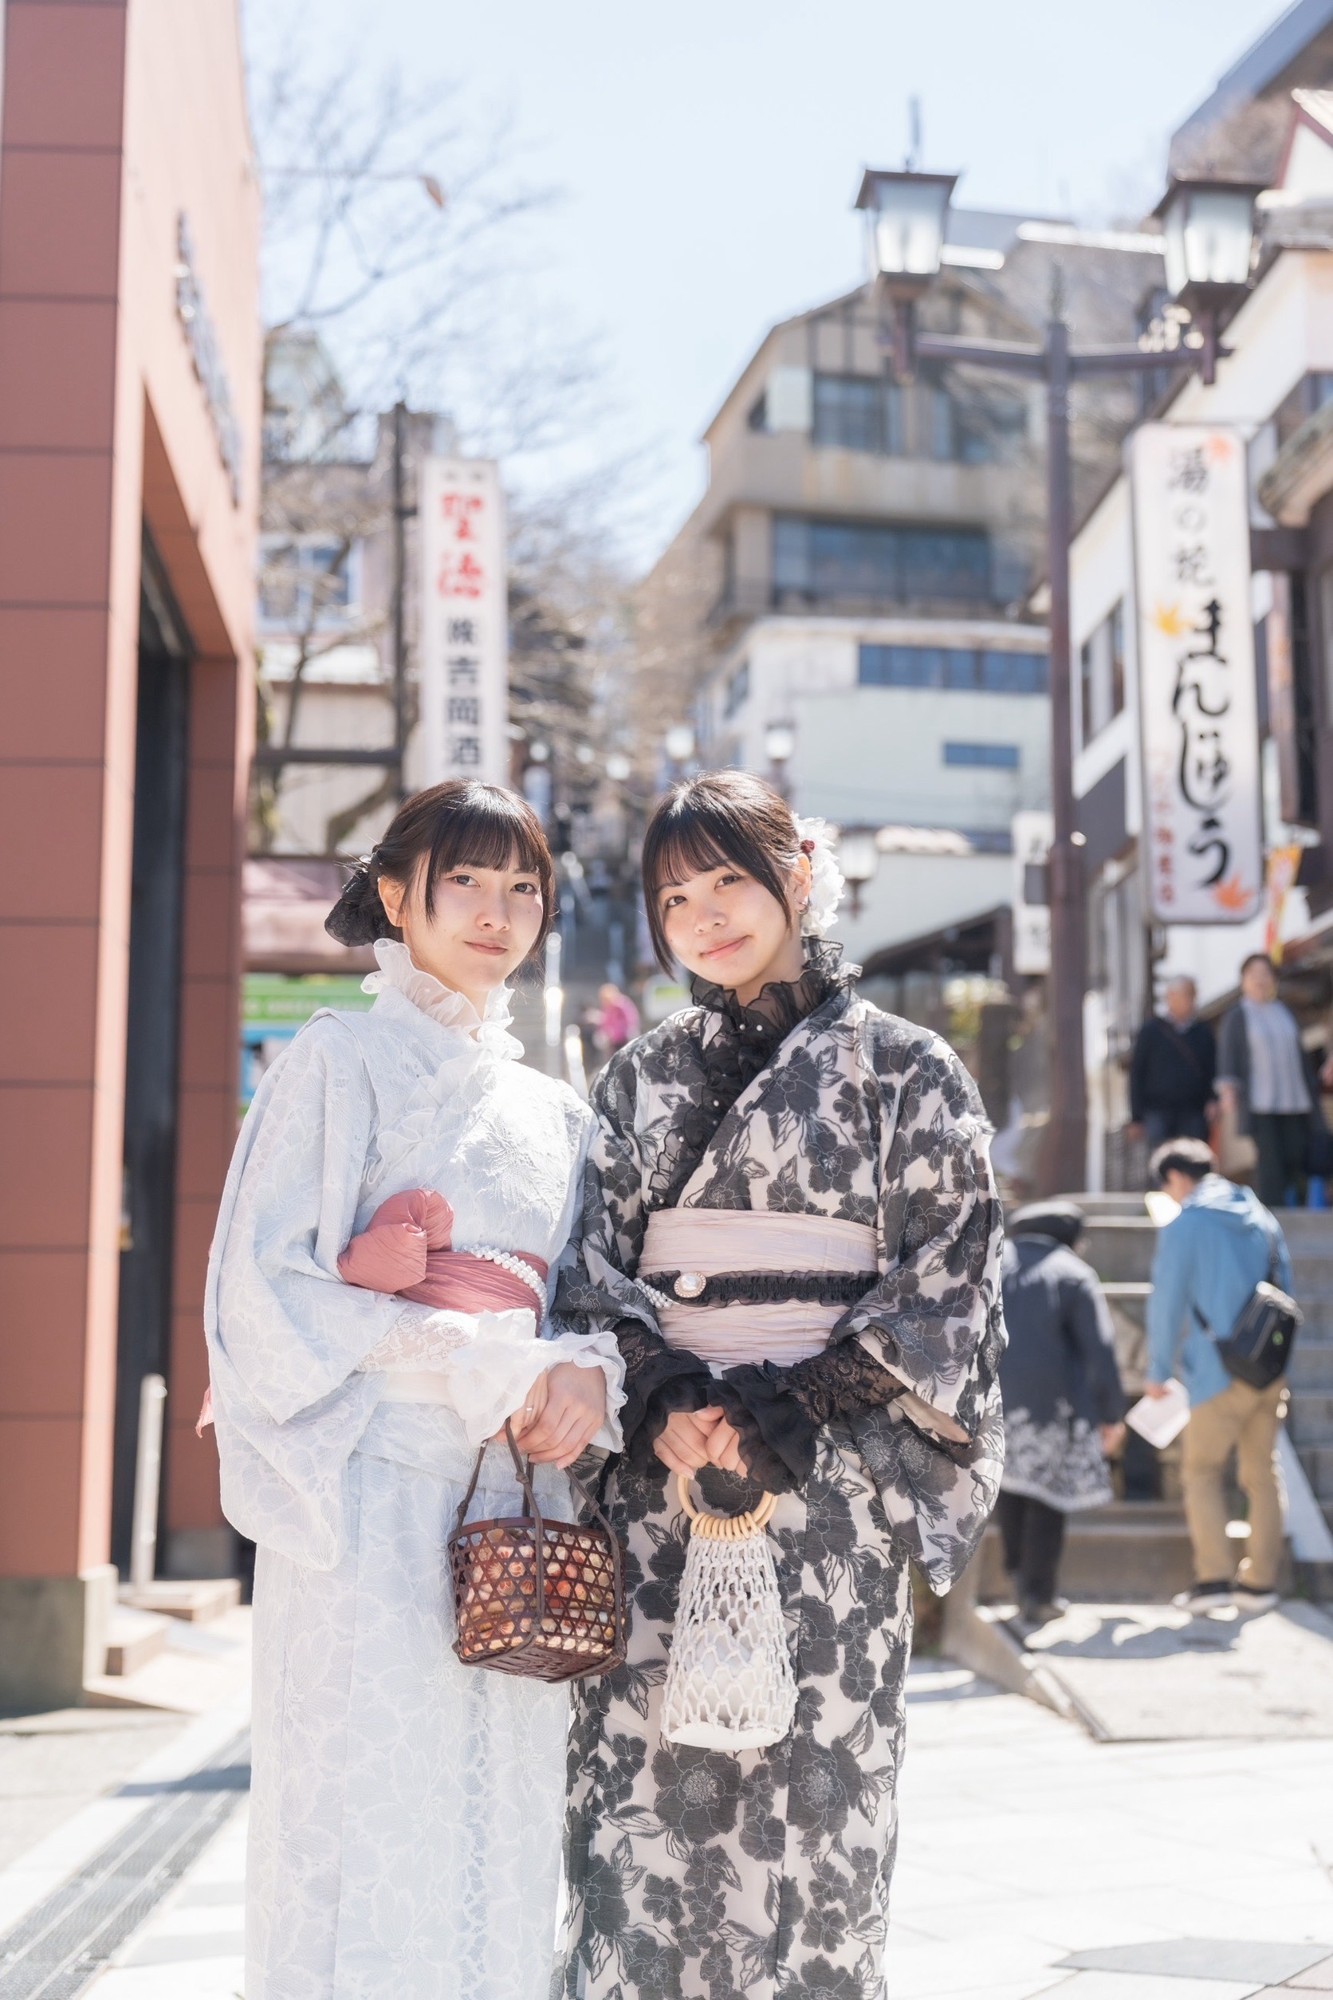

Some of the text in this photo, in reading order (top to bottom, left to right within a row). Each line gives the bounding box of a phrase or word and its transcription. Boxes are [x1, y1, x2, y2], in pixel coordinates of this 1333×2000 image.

[1171, 597, 1231, 889] まんじゅう
